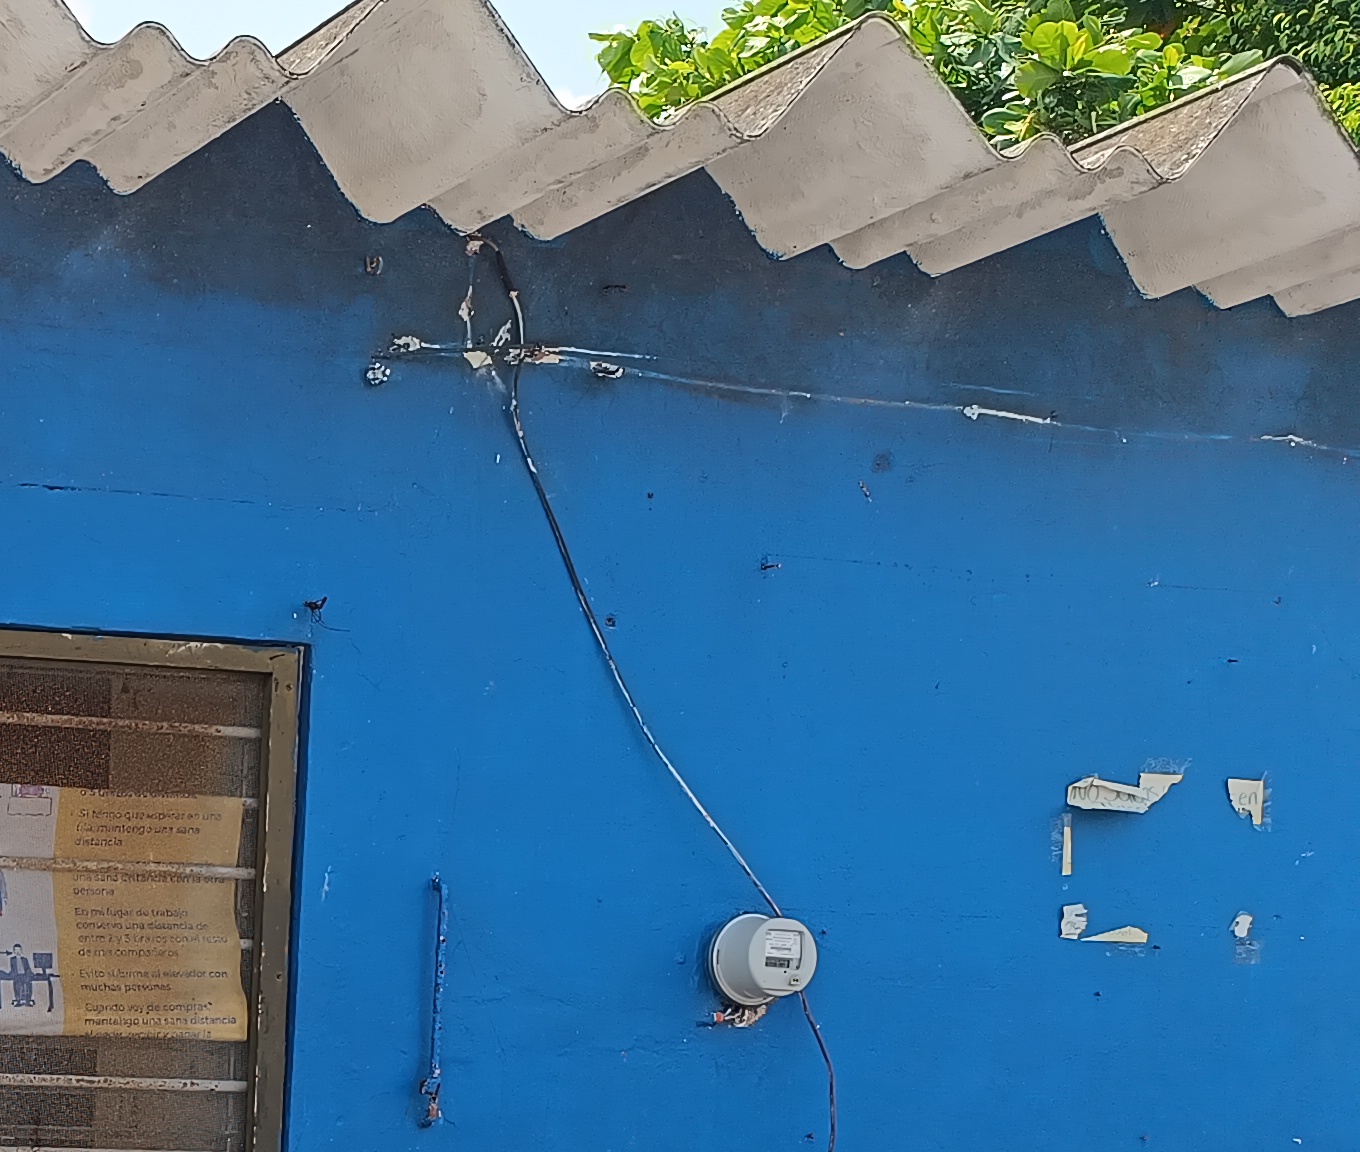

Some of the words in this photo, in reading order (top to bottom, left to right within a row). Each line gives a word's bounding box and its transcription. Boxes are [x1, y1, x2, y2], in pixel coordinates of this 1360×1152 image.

[208, 970, 229, 979] con
[80, 981, 122, 993] muchas
[85, 1001, 125, 1013] Cuando
[141, 1017, 163, 1027] una
[189, 1015, 237, 1026] distancia
